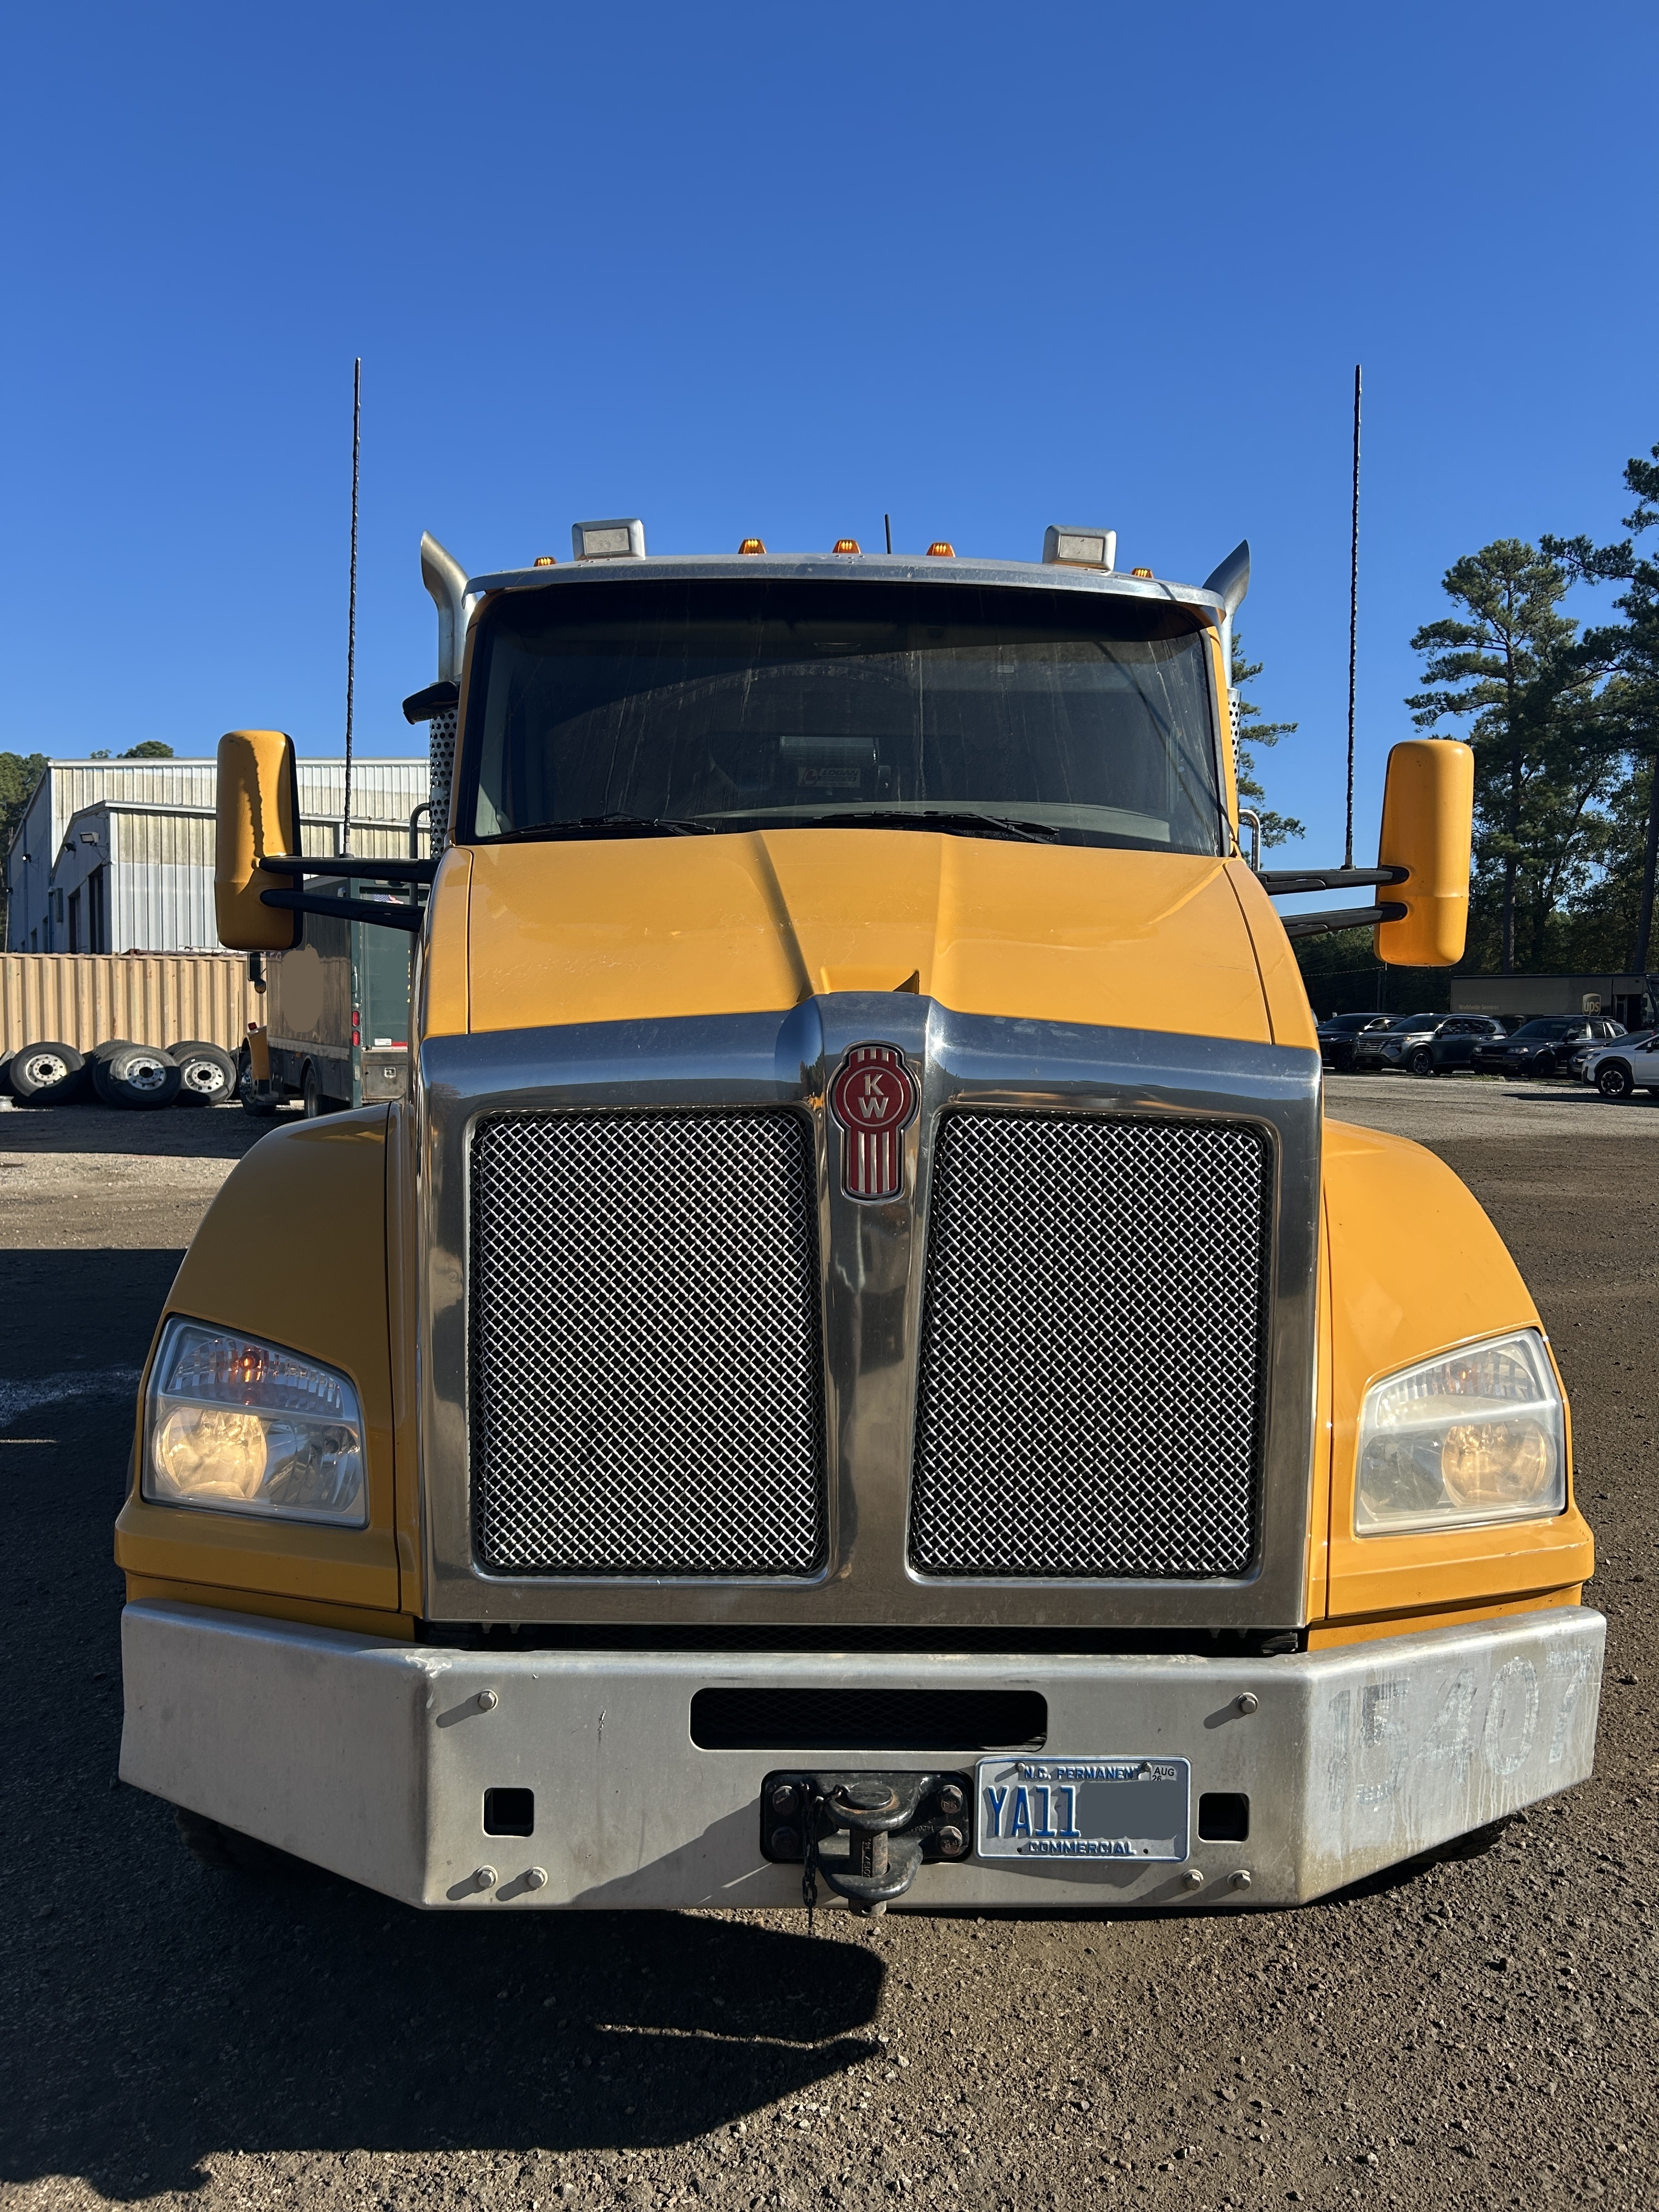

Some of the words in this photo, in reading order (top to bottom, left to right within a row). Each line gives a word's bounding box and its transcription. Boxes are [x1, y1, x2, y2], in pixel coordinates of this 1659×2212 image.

[865, 1074, 884, 1096] K
[858, 1097, 889, 1118] W
[1024, 1767, 1051, 1780] N.C.
[1057, 1767, 1142, 1780] PERMANENT
[1154, 1767, 1175, 1776] AUG
[988, 1785, 1081, 1837] YA11
[1029, 1841, 1137, 1855] COMMERCIAL
